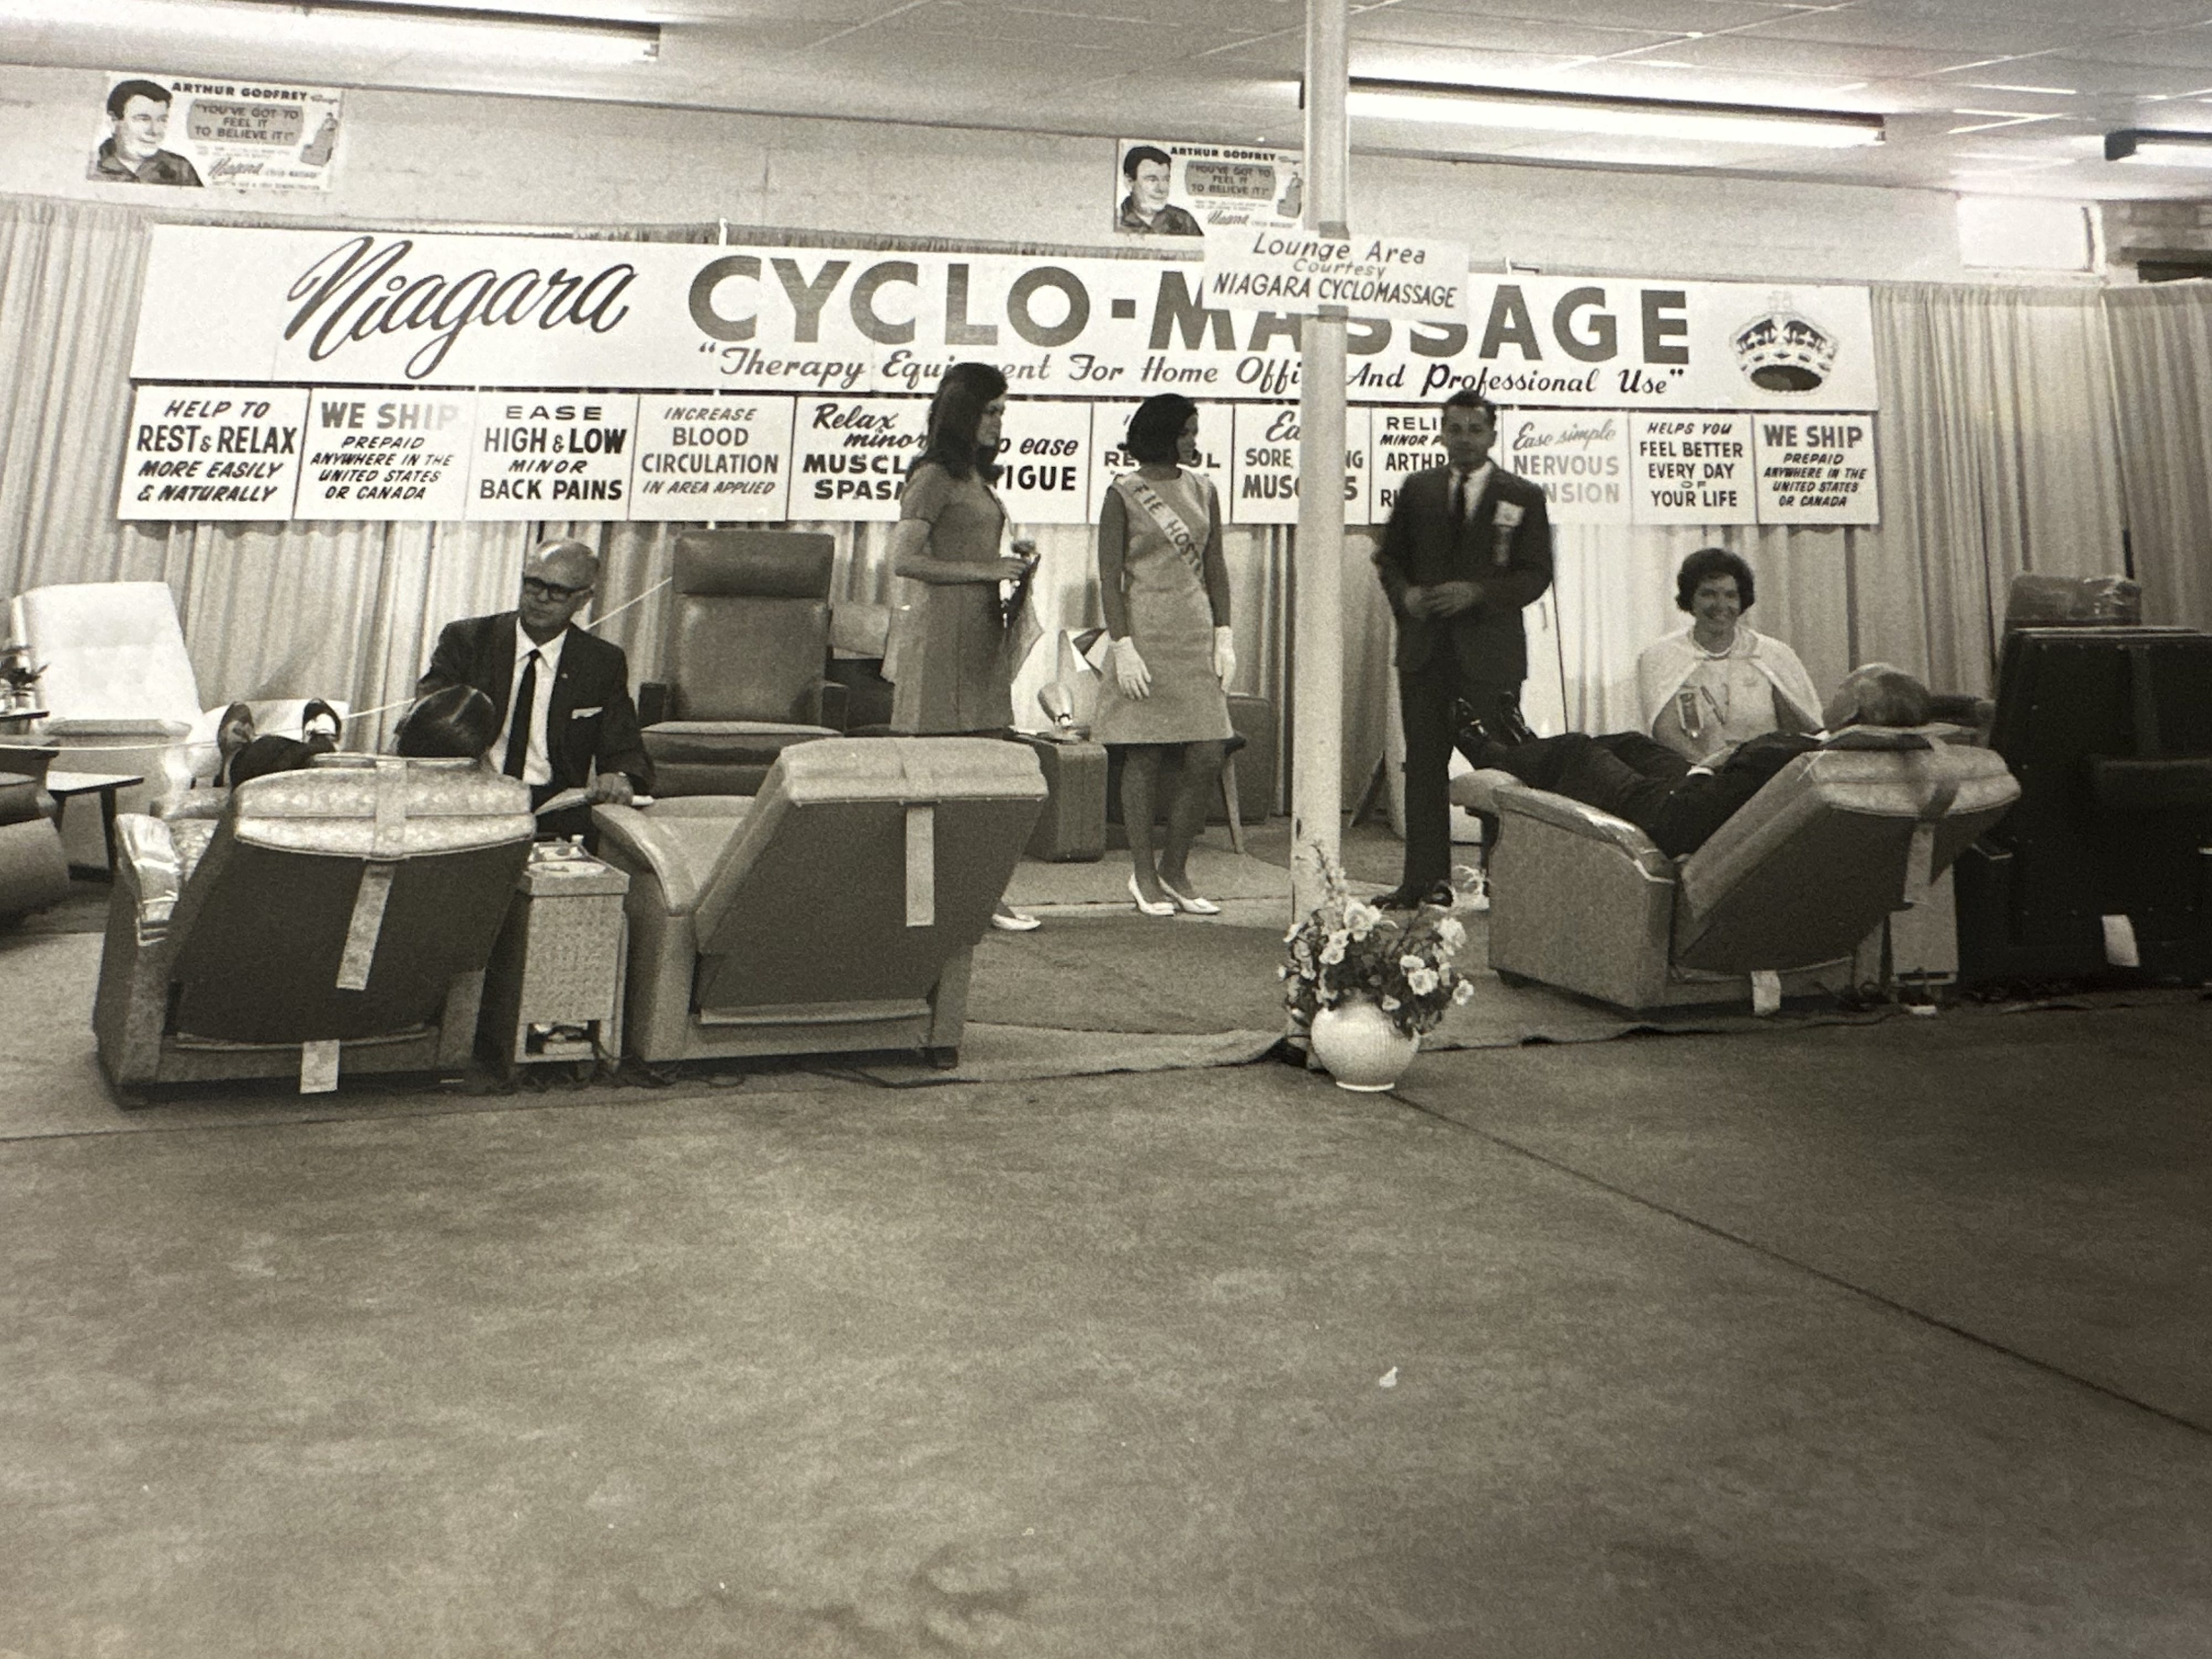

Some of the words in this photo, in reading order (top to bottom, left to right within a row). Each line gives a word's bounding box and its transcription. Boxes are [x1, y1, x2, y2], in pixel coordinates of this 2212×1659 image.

[171, 82, 234, 96] ARTHUR
[242, 88, 307, 102] GODFREY
[251, 107, 276, 118] GOT
[283, 109, 299, 119] TO
[223, 117, 251, 127] FEEL
[195, 126, 211, 136] TO
[217, 128, 268, 139] BELIEVE
[1171, 147, 1218, 156] ARTHUR
[1224, 150, 1276, 161] GODFREY
[1213, 175, 1233, 184] FEEL
[1259, 169, 1271, 178] TO
[1191, 184, 1204, 192] TO
[1209, 184, 1249, 194] BELIEVE
[1253, 232, 1350, 261] Lounge
[1366, 241, 1426, 264] Area
[1292, 259, 1386, 278] Courtesy
[1213, 273, 1311, 298] NIAGARA
[1318, 278, 1458, 309] CYCLOMASSAGE
[284, 236, 639, 379] Niagara
[881, 349, 1051, 390] Equient
[1069, 356, 1123, 383] For
[1141, 356, 1218, 383] Home
[1235, 356, 1302, 394] Offi
[1347, 362, 1405, 388] And
[1420, 362, 1599, 397] Professional
[164, 400, 232, 418] HELP
[240, 401, 270, 419] TO
[321, 401, 365, 429] WE
[377, 403, 460, 430] SHIP
[505, 405, 603, 421] EASE
[664, 407, 758, 421] INCREASE
[812, 403, 899, 430] Relax
[1386, 417, 1437, 430] RELI
[1647, 421, 1694, 435] HELPS
[1702, 422, 1732, 435] YOU
[136, 425, 201, 452] REST
[217, 426, 298, 454] RELAX
[341, 436, 425, 449] PREPAID
[484, 427, 547, 453] HIGH
[553, 435, 565, 453] &
[568, 429, 627, 455] LOW
[672, 427, 749, 446] BLOOD
[843, 427, 928, 450] minor
[1019, 437, 1079, 456] ease
[1380, 434, 1428, 446] MINOR
[1513, 421, 1553, 451] Ease
[1554, 418, 1616, 451] simple
[1763, 425, 1797, 447] WE
[1806, 425, 1864, 448] SHIP
[1640, 441, 1677, 458] FEEL
[1683, 442, 1744, 458] BETTER
[310, 453, 398, 466] ANYWHERE
[401, 454, 420, 466] IN
[425, 455, 455, 467] THE
[508, 460, 588, 474] MINOR
[642, 453, 779, 474] CIRCULATION
[1385, 452, 1446, 471] ARTHR
[1513, 455, 1619, 476] NERVOUS
[1783, 453, 1844, 465] PREPAID
[138, 460, 204, 478] MORE
[207, 461, 284, 479] EASILY
[318, 470, 379, 482] UNITED
[386, 470, 442, 483] STATES
[802, 454, 907, 474] MUSCL
[994, 465, 1076, 491] IGUE
[1648, 463, 1695, 479] EVERY
[1704, 463, 1735, 479] DAY
[1764, 467, 1823, 478] ANYWHERE
[1827, 468, 1839, 478] IN
[1845, 468, 1867, 479] THE
[480, 479, 541, 499] BACK
[553, 479, 623, 500] PAINS
[643, 481, 664, 494] IN
[667, 481, 709, 494] AREA
[713, 482, 776, 495] APPLIED
[813, 479, 902, 500] SPAS
[1543, 483, 1620, 503] NSION
[1681, 481, 1707, 489] OF
[1772, 481, 1815, 492] UNITED
[1819, 481, 1859, 493] STATES
[137, 486, 150, 502] &
[156, 486, 278, 502] NATURALLY
[325, 487, 348, 499] OR
[356, 487, 426, 500] CANADA
[1650, 491, 1695, 507] YOUR
[1703, 491, 1738, 508] LIFE
[1778, 496, 1796, 507] OR
[1800, 496, 1848, 507] CANADA
